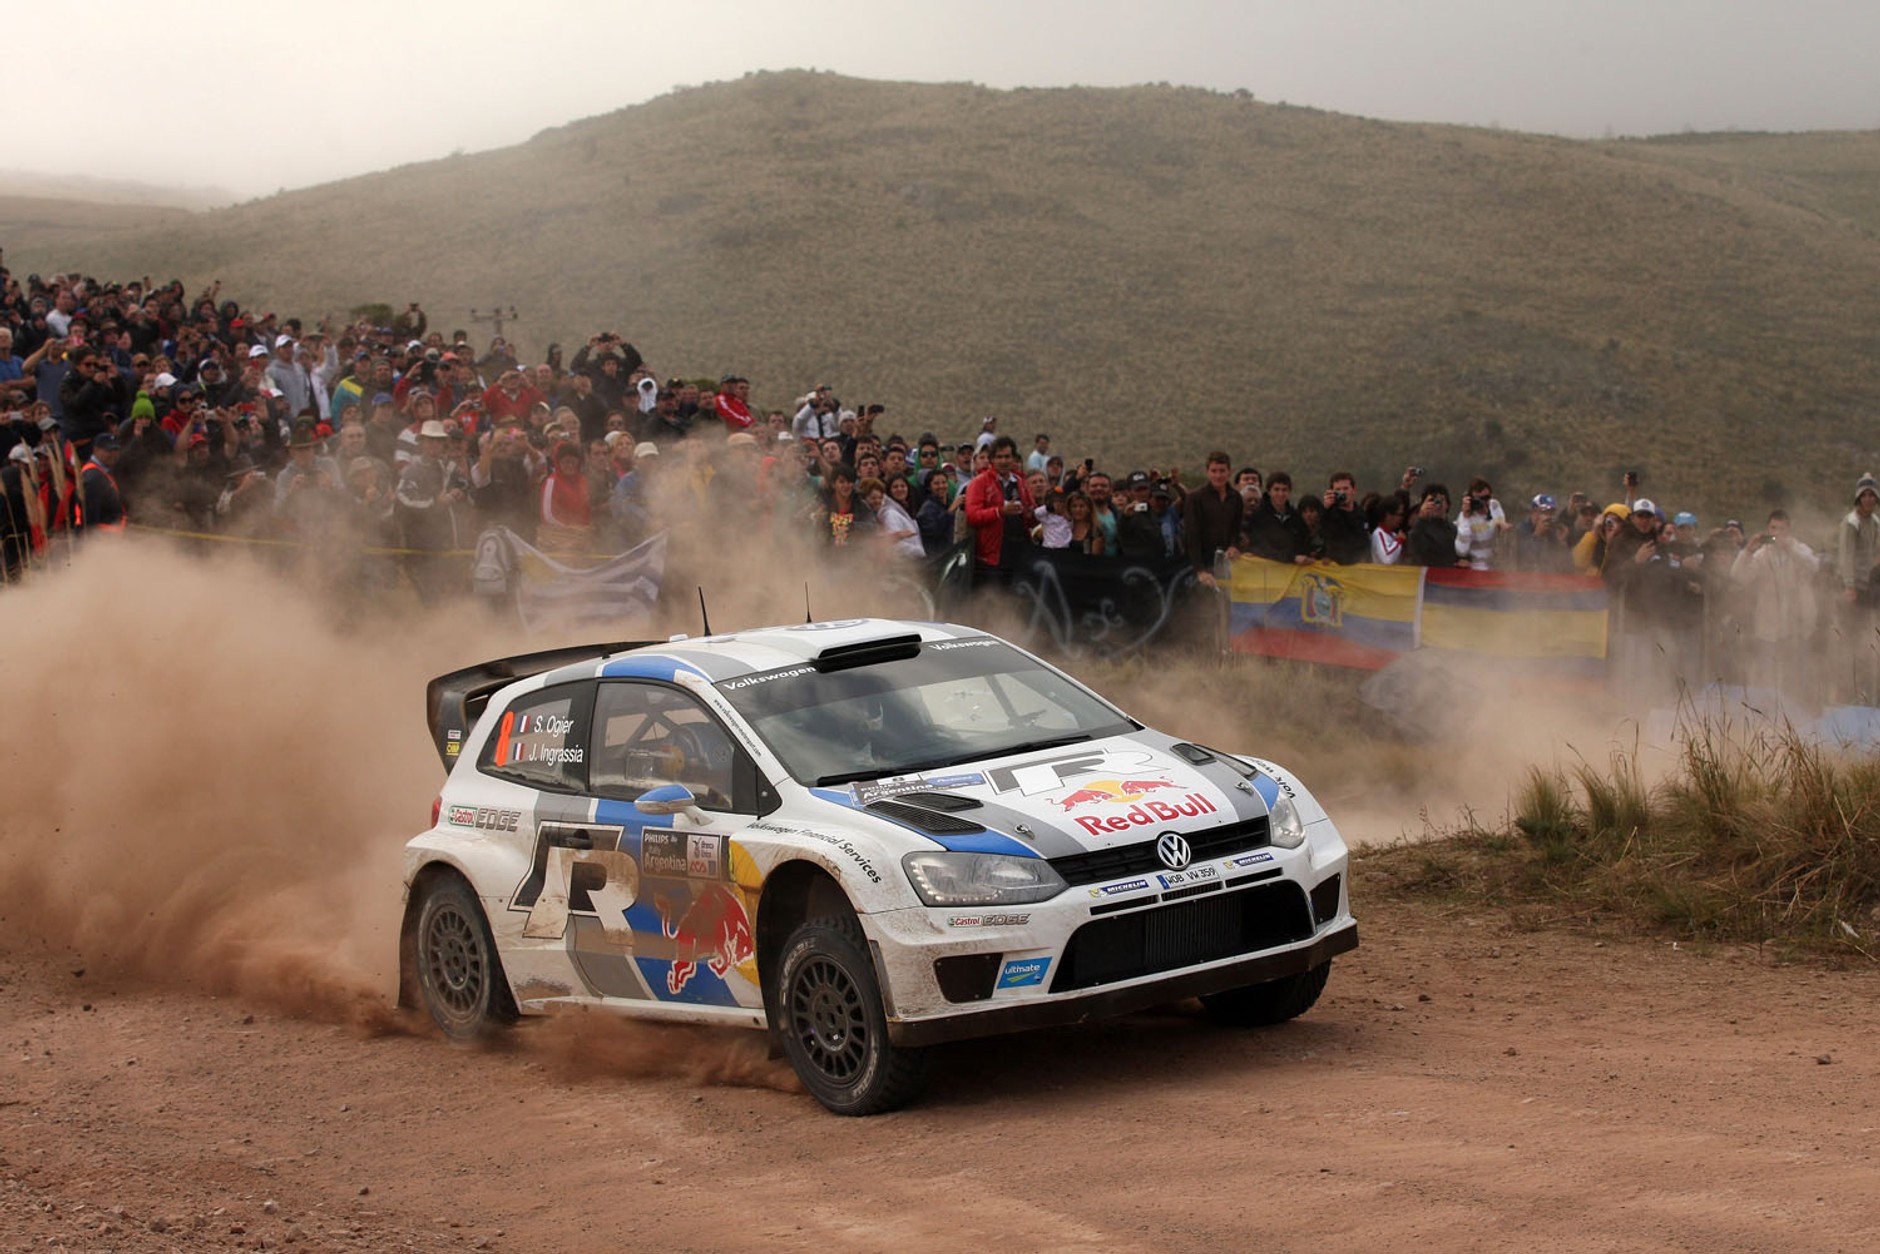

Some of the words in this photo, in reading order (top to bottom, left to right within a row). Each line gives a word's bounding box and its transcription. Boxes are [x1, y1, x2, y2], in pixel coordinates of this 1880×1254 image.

[929, 640, 1000, 650] Volkswagen
[723, 665, 817, 691] Volkswagen
[534, 715, 544, 733] S.
[546, 715, 574, 737] Ogier
[494, 711, 515, 767] 8
[528, 743, 538, 762] J.
[540, 744, 584, 766] Ingrassia
[863, 784, 934, 799] Argentina
[455, 808, 476, 824] Castrol
[475, 808, 522, 832] EDGE
[1073, 804, 1155, 836] Red
[1145, 793, 1217, 821] Bull
[644, 833, 670, 845] PHILIPS
[644, 852, 687, 872] Argentina
[747, 821, 797, 834] Volkswagen
[797, 829, 845, 846] Financial
[838, 841, 883, 884] Services
[1238, 854, 1272, 866] MICHELIN
[1167, 873, 1185, 886] WOB
[1186, 872, 1200, 881] VW
[1200, 867, 1216, 878] 359
[1107, 880, 1147, 893] MICHELIN
[955, 917, 981, 926] Castrol
[982, 914, 1031, 926] EDGE
[1005, 963, 1041, 974] ultimate
